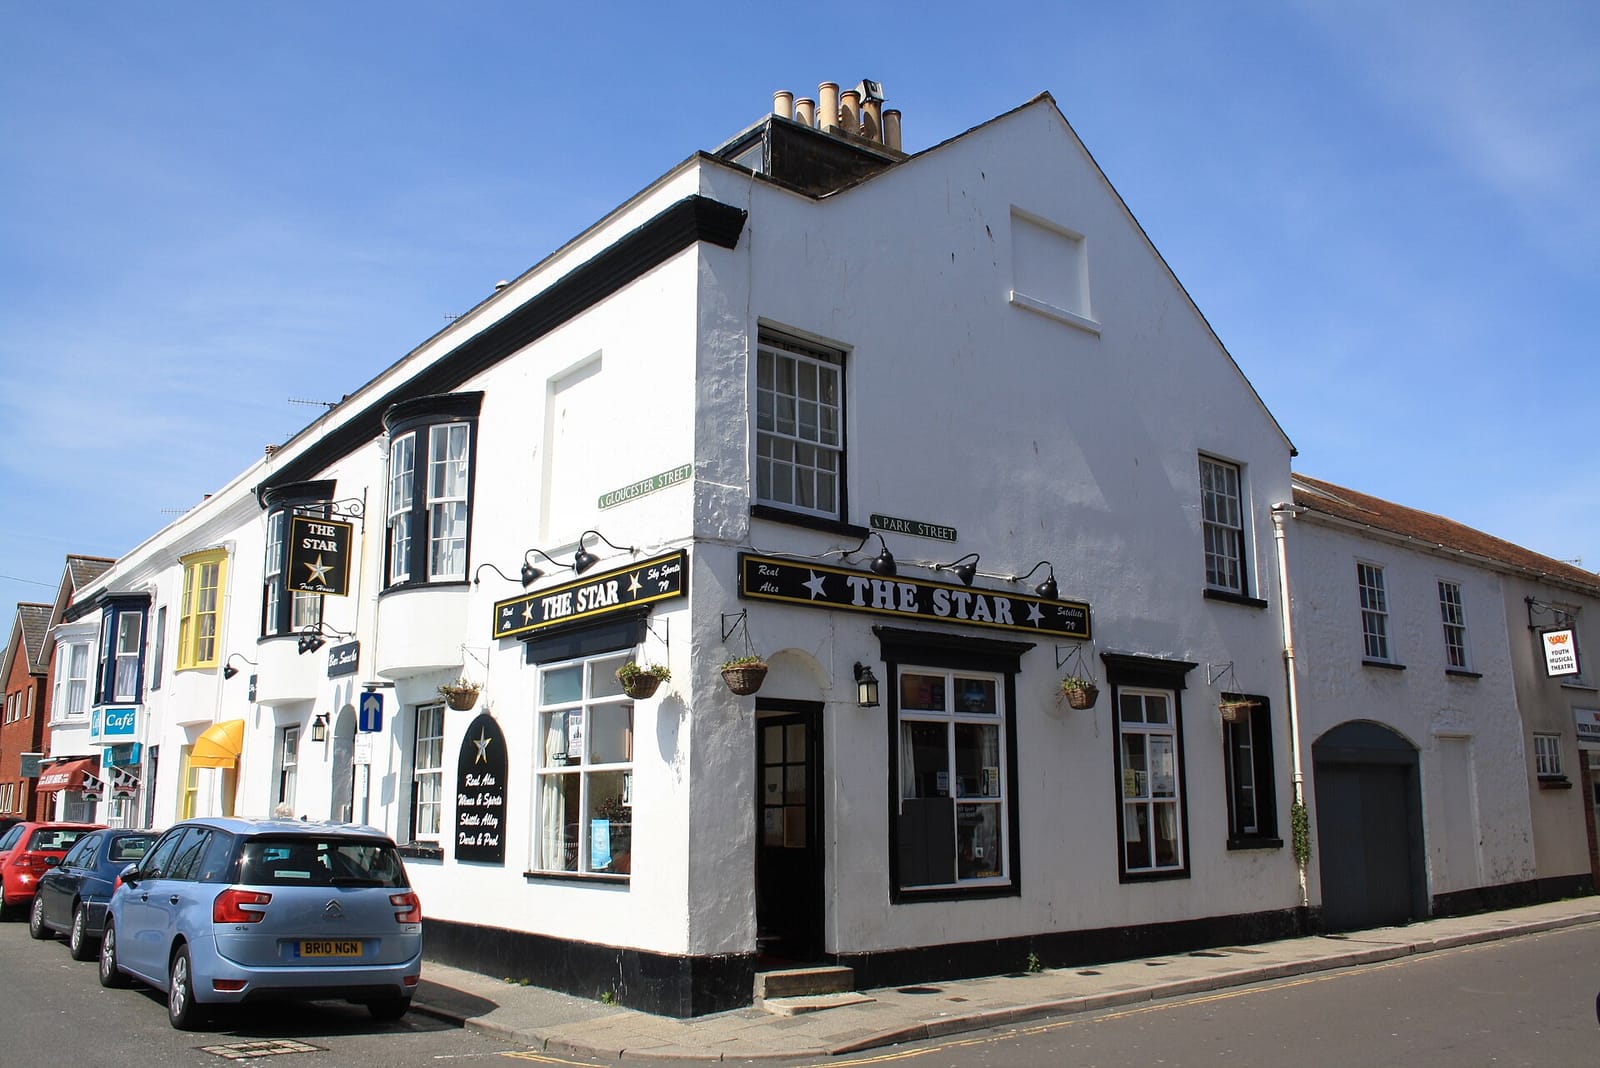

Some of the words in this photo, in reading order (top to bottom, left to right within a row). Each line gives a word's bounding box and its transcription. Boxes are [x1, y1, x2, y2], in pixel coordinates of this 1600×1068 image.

[606, 479, 654, 506] GLOUCESTER
[658, 465, 690, 487] STREET
[308, 524, 335, 537] THE
[883, 517, 911, 532] PARK
[918, 523, 955, 540] STREET
[302, 538, 338, 553] STAR
[647, 568, 660, 580] Sky
[660, 564, 681, 577] Sports
[758, 564, 779, 577] Real
[299, 582, 314, 590] Free
[316, 584, 336, 593] House
[759, 581, 779, 593] Ales
[541, 592, 572, 620] THE
[577, 580, 619, 612] STAR
[846, 575, 919, 613] THE
[932, 588, 1015, 625] STAR
[1056, 606, 1084, 619] Satellite
[1547, 634, 1569, 644] WOW
[1551, 648, 1569, 656] YOUTH
[1549, 655, 1573, 664] MUSICAL
[1551, 663, 1574, 671] THEATRE
[106, 712, 135, 730] Café
[465, 774, 480, 787] Real
[480, 772, 496, 786] Ales
[457, 793, 476, 806] Wines
[476, 793, 482, 806] &
[476, 832, 482, 846] &
[483, 833, 499, 847] Pool
[335, 941, 358, 954] NGN
